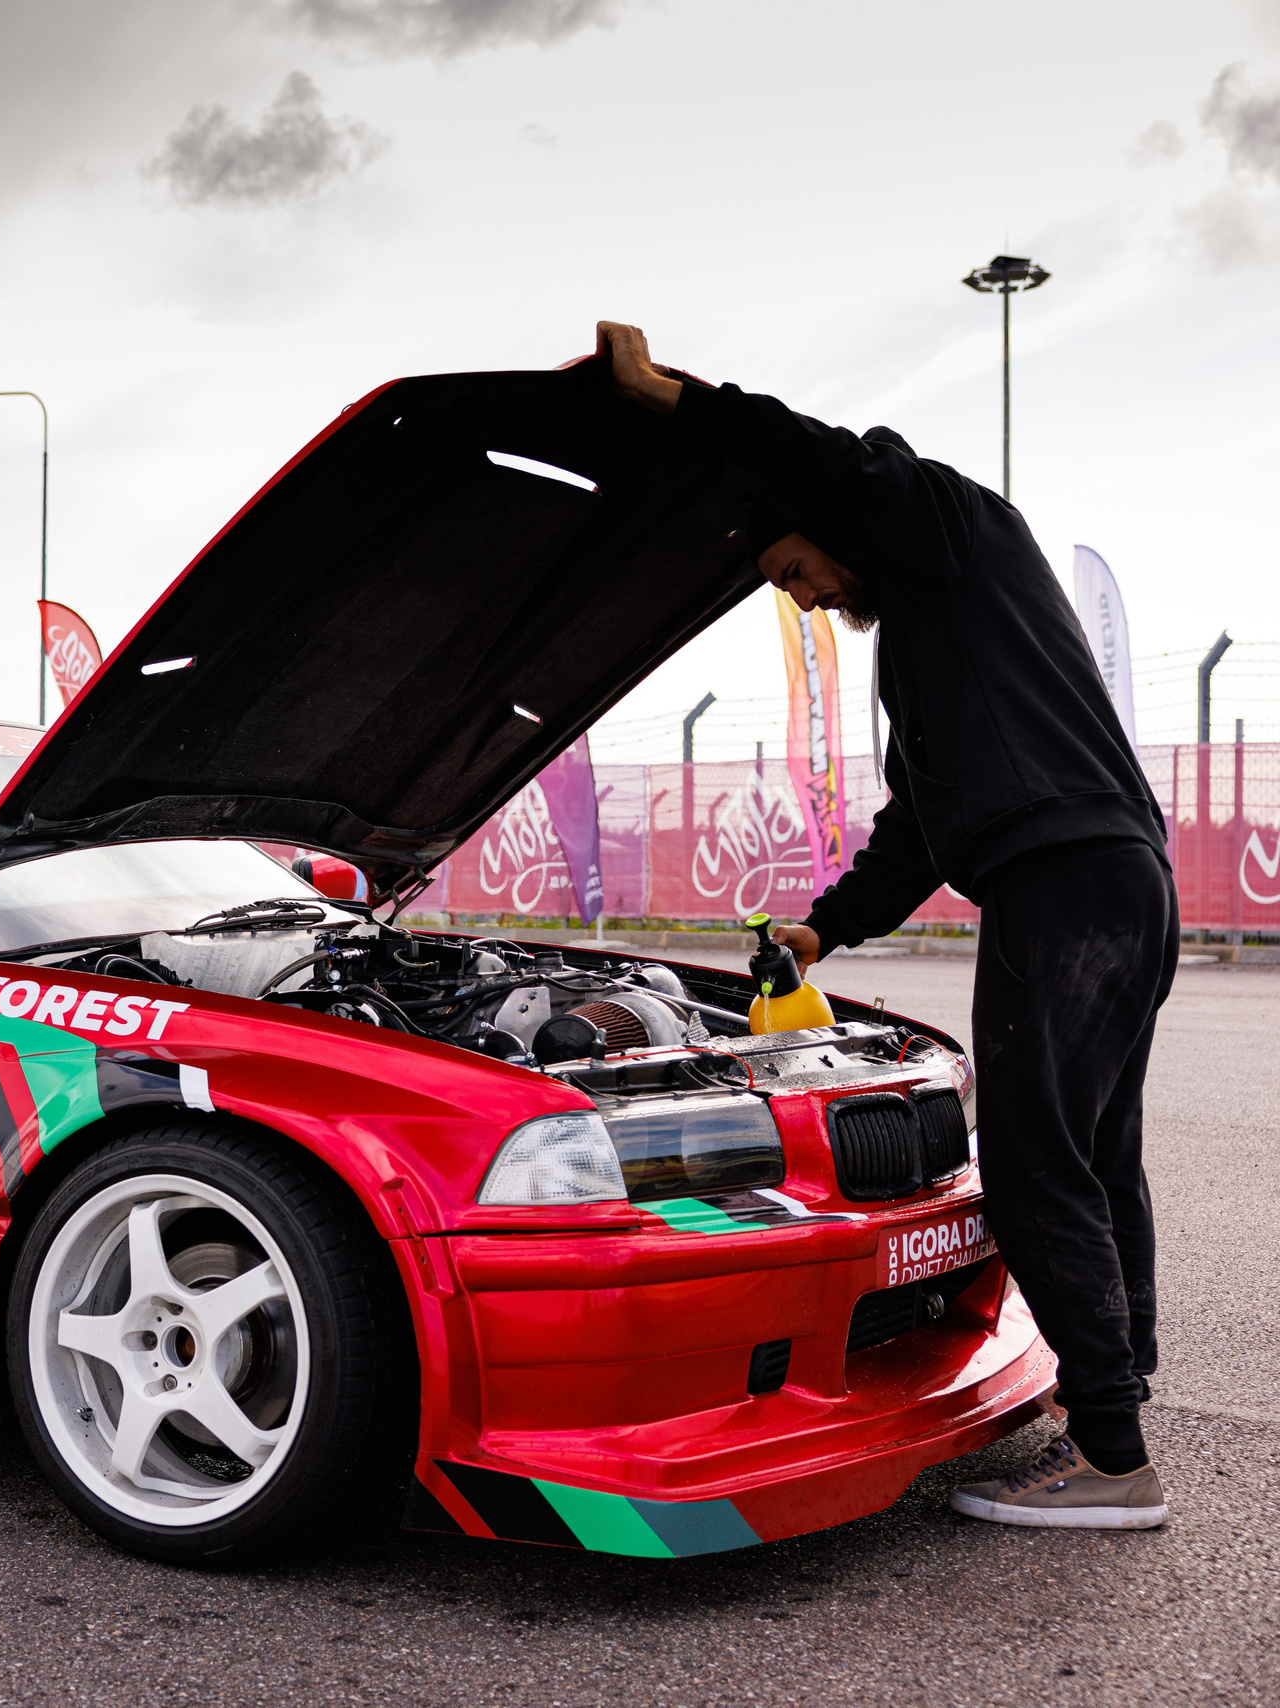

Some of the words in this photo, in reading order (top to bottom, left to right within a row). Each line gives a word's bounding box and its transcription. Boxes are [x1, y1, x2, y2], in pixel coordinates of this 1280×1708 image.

[776, 876, 814, 891] ДРА
[902, 1221, 962, 1264] IGORA
[965, 1213, 989, 1247] DRI
[900, 1258, 943, 1285] DRIFT
